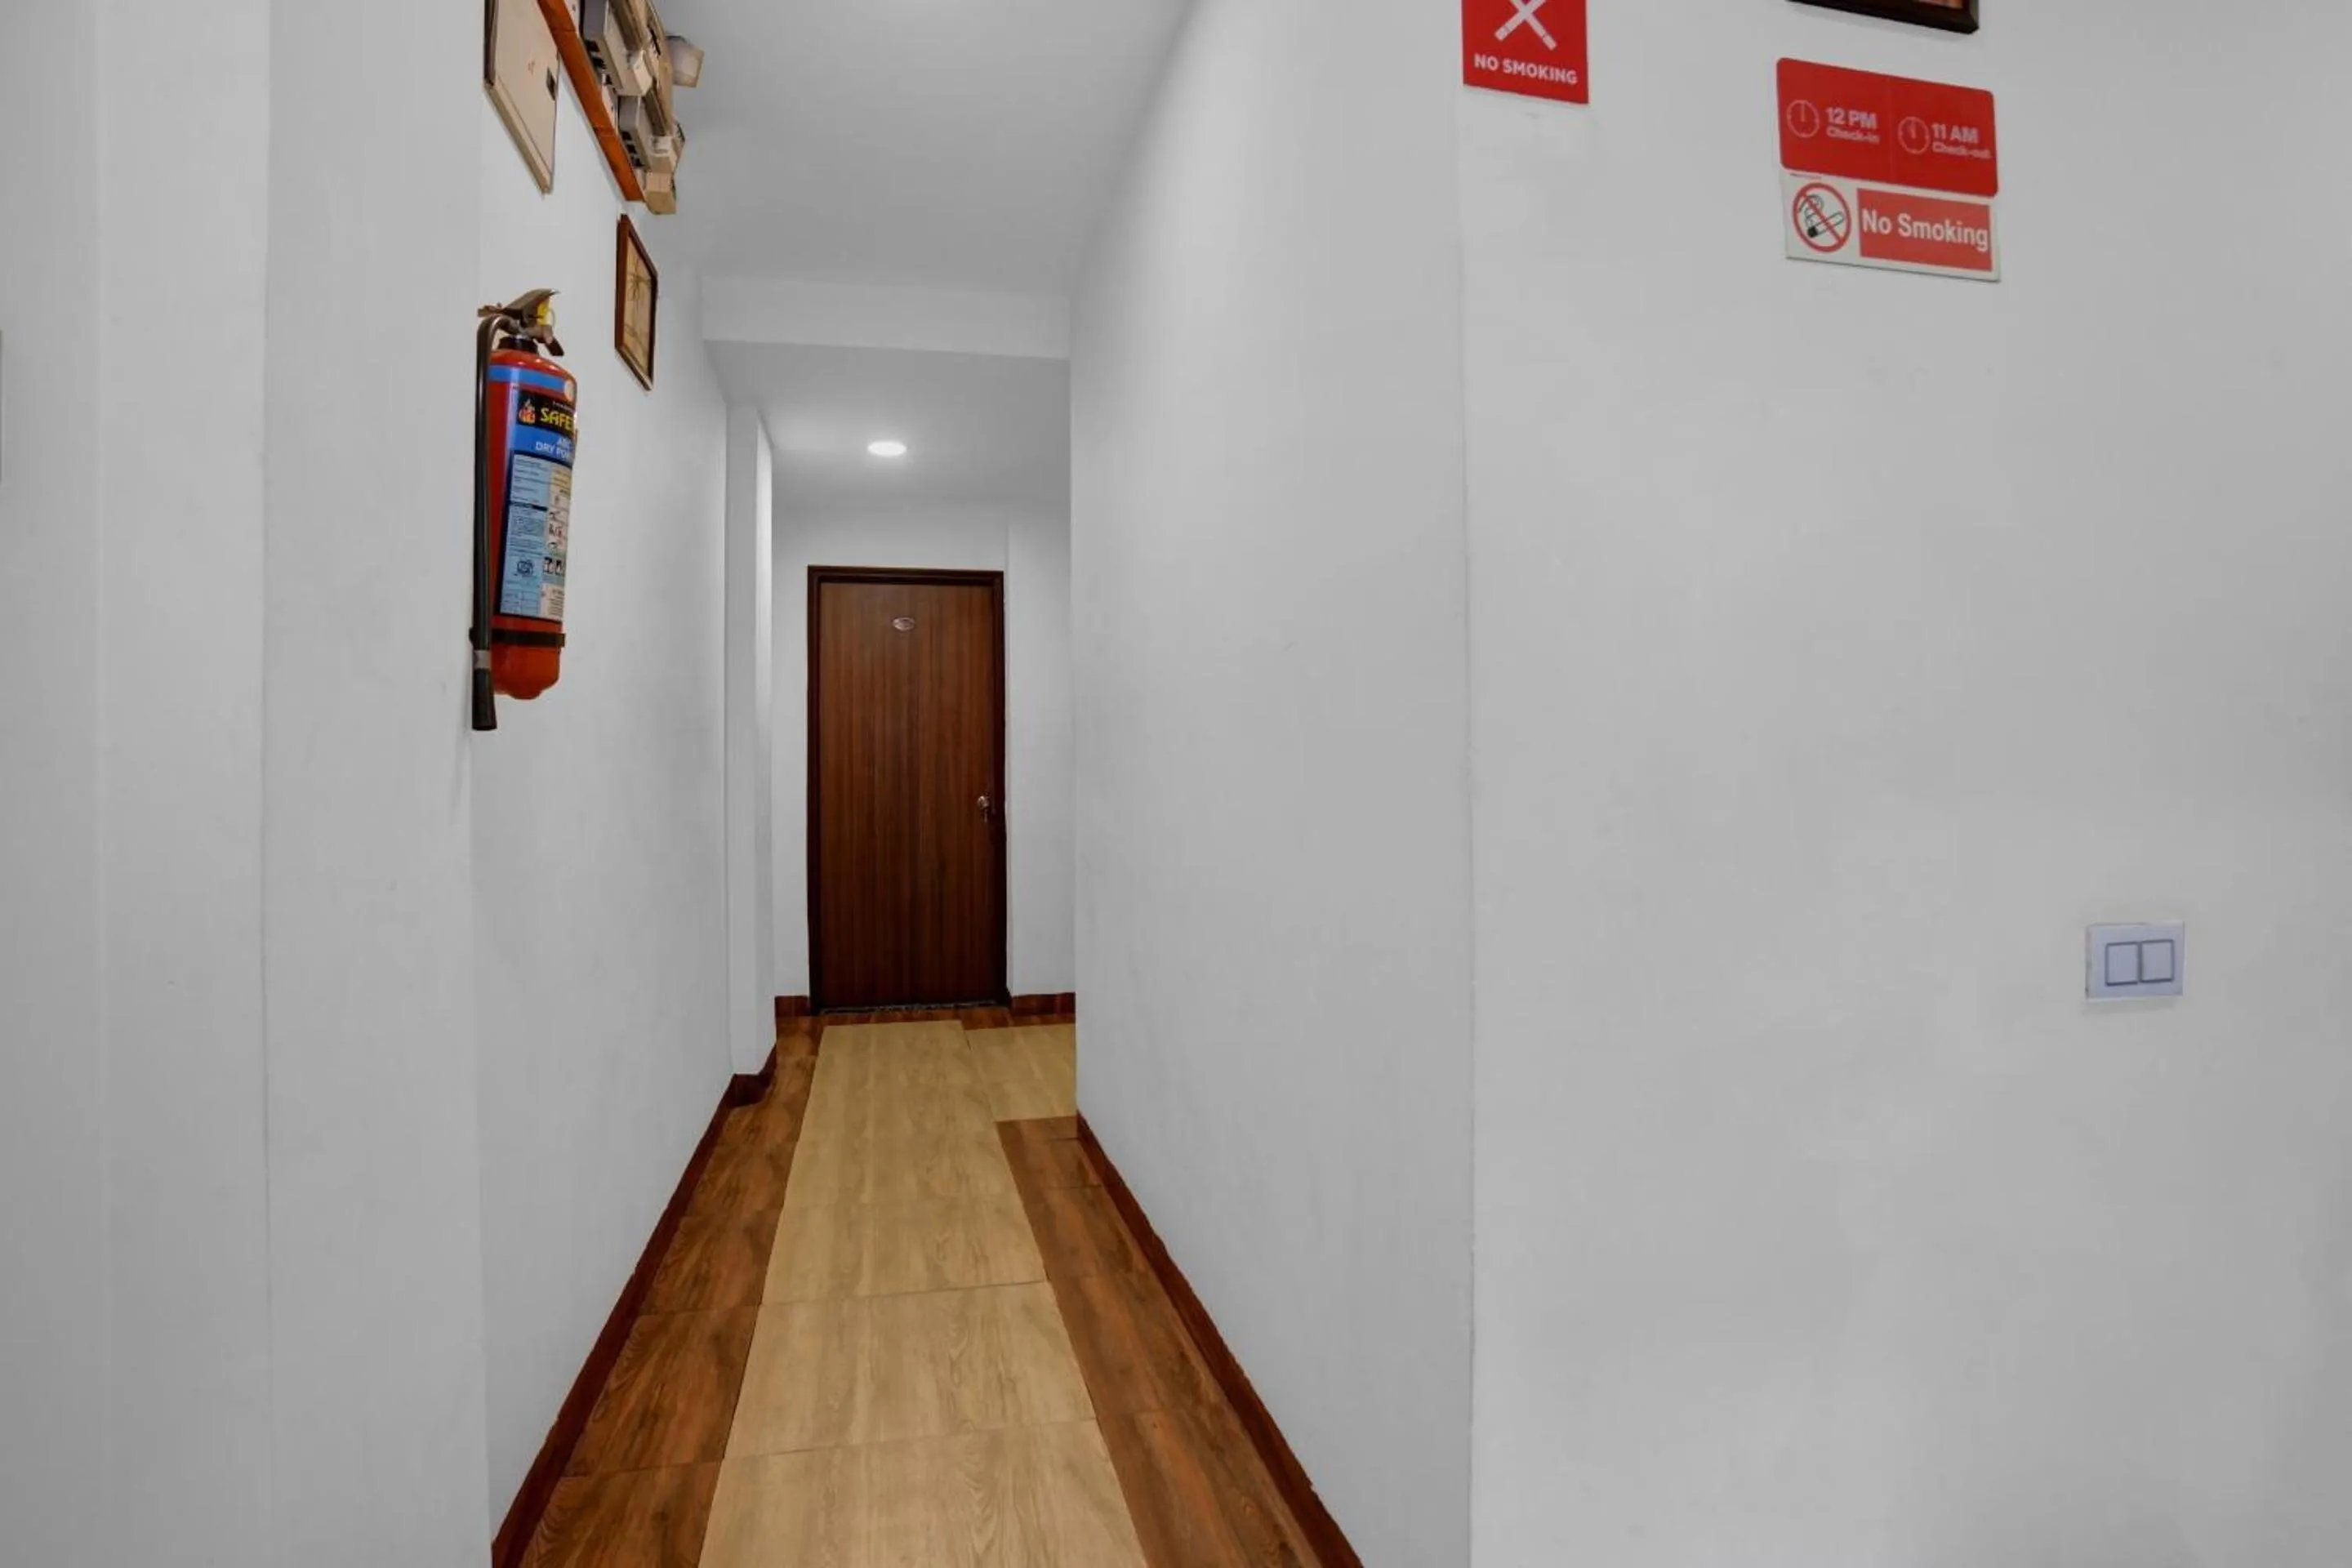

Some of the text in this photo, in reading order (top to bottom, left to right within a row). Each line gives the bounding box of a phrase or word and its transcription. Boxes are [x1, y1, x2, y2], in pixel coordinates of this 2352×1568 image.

[1473, 52, 1578, 85] NO SMOKING
[1826, 107, 1877, 131] 12 PM
[1826, 126, 1881, 145] Check-in
[1931, 122, 1979, 144] 11 AM
[1861, 207, 1989, 252] No Smoking
